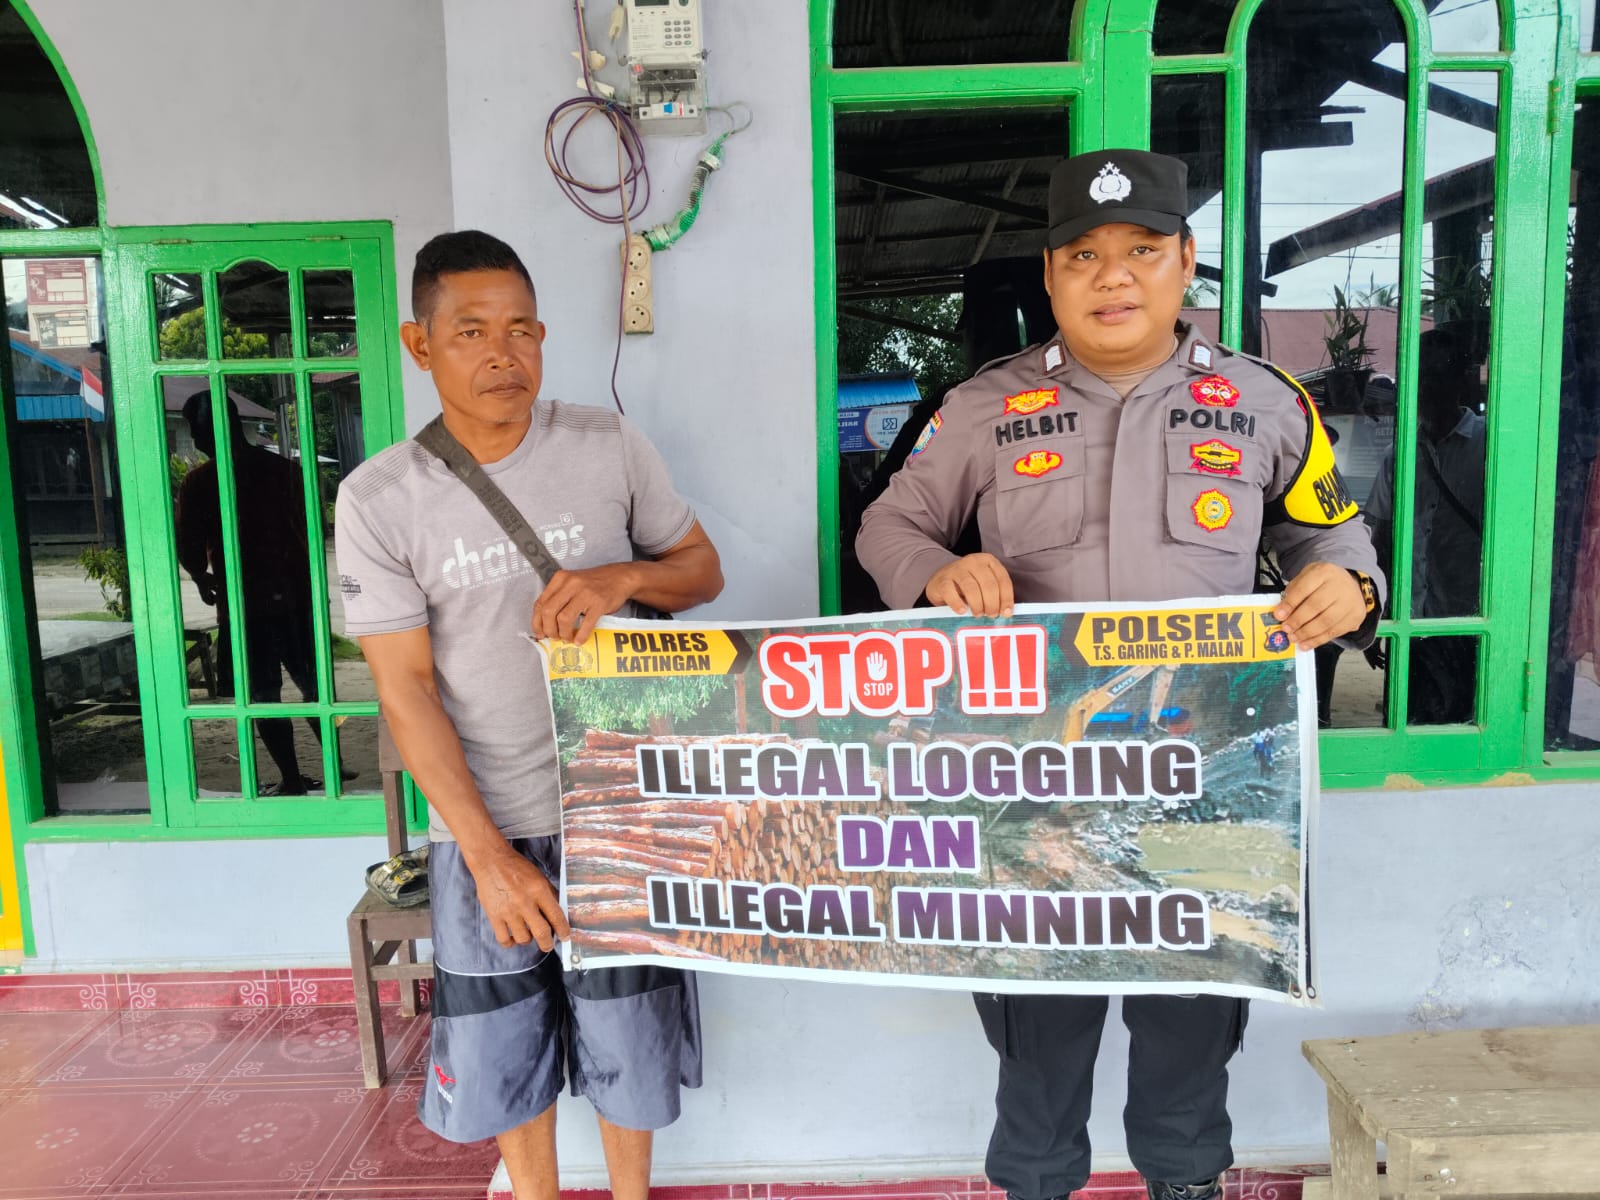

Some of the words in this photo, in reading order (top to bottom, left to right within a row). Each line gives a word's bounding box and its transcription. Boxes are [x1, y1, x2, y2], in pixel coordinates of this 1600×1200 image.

[996, 412, 1078, 446] HELBIT
[1169, 408, 1256, 438] POLRI
[613, 632, 709, 653] POLRES
[1092, 612, 1245, 644] POLSEK
[616, 655, 711, 673] KATINGAN
[1093, 644, 1115, 660] T.S.
[1118, 643, 1168, 660] GARING
[1171, 645, 1181, 659] &
[1184, 643, 1195, 658] P.
[1199, 641, 1243, 658] MALAN
[763, 634, 949, 714] STOP
[863, 682, 894, 697] STOP
[638, 746, 877, 798] ILLEGAL
[892, 743, 1199, 799] LOGGING
[840, 818, 978, 870] DAN
[650, 878, 882, 938] ILLEGAL
[895, 889, 1207, 947] MINNING
